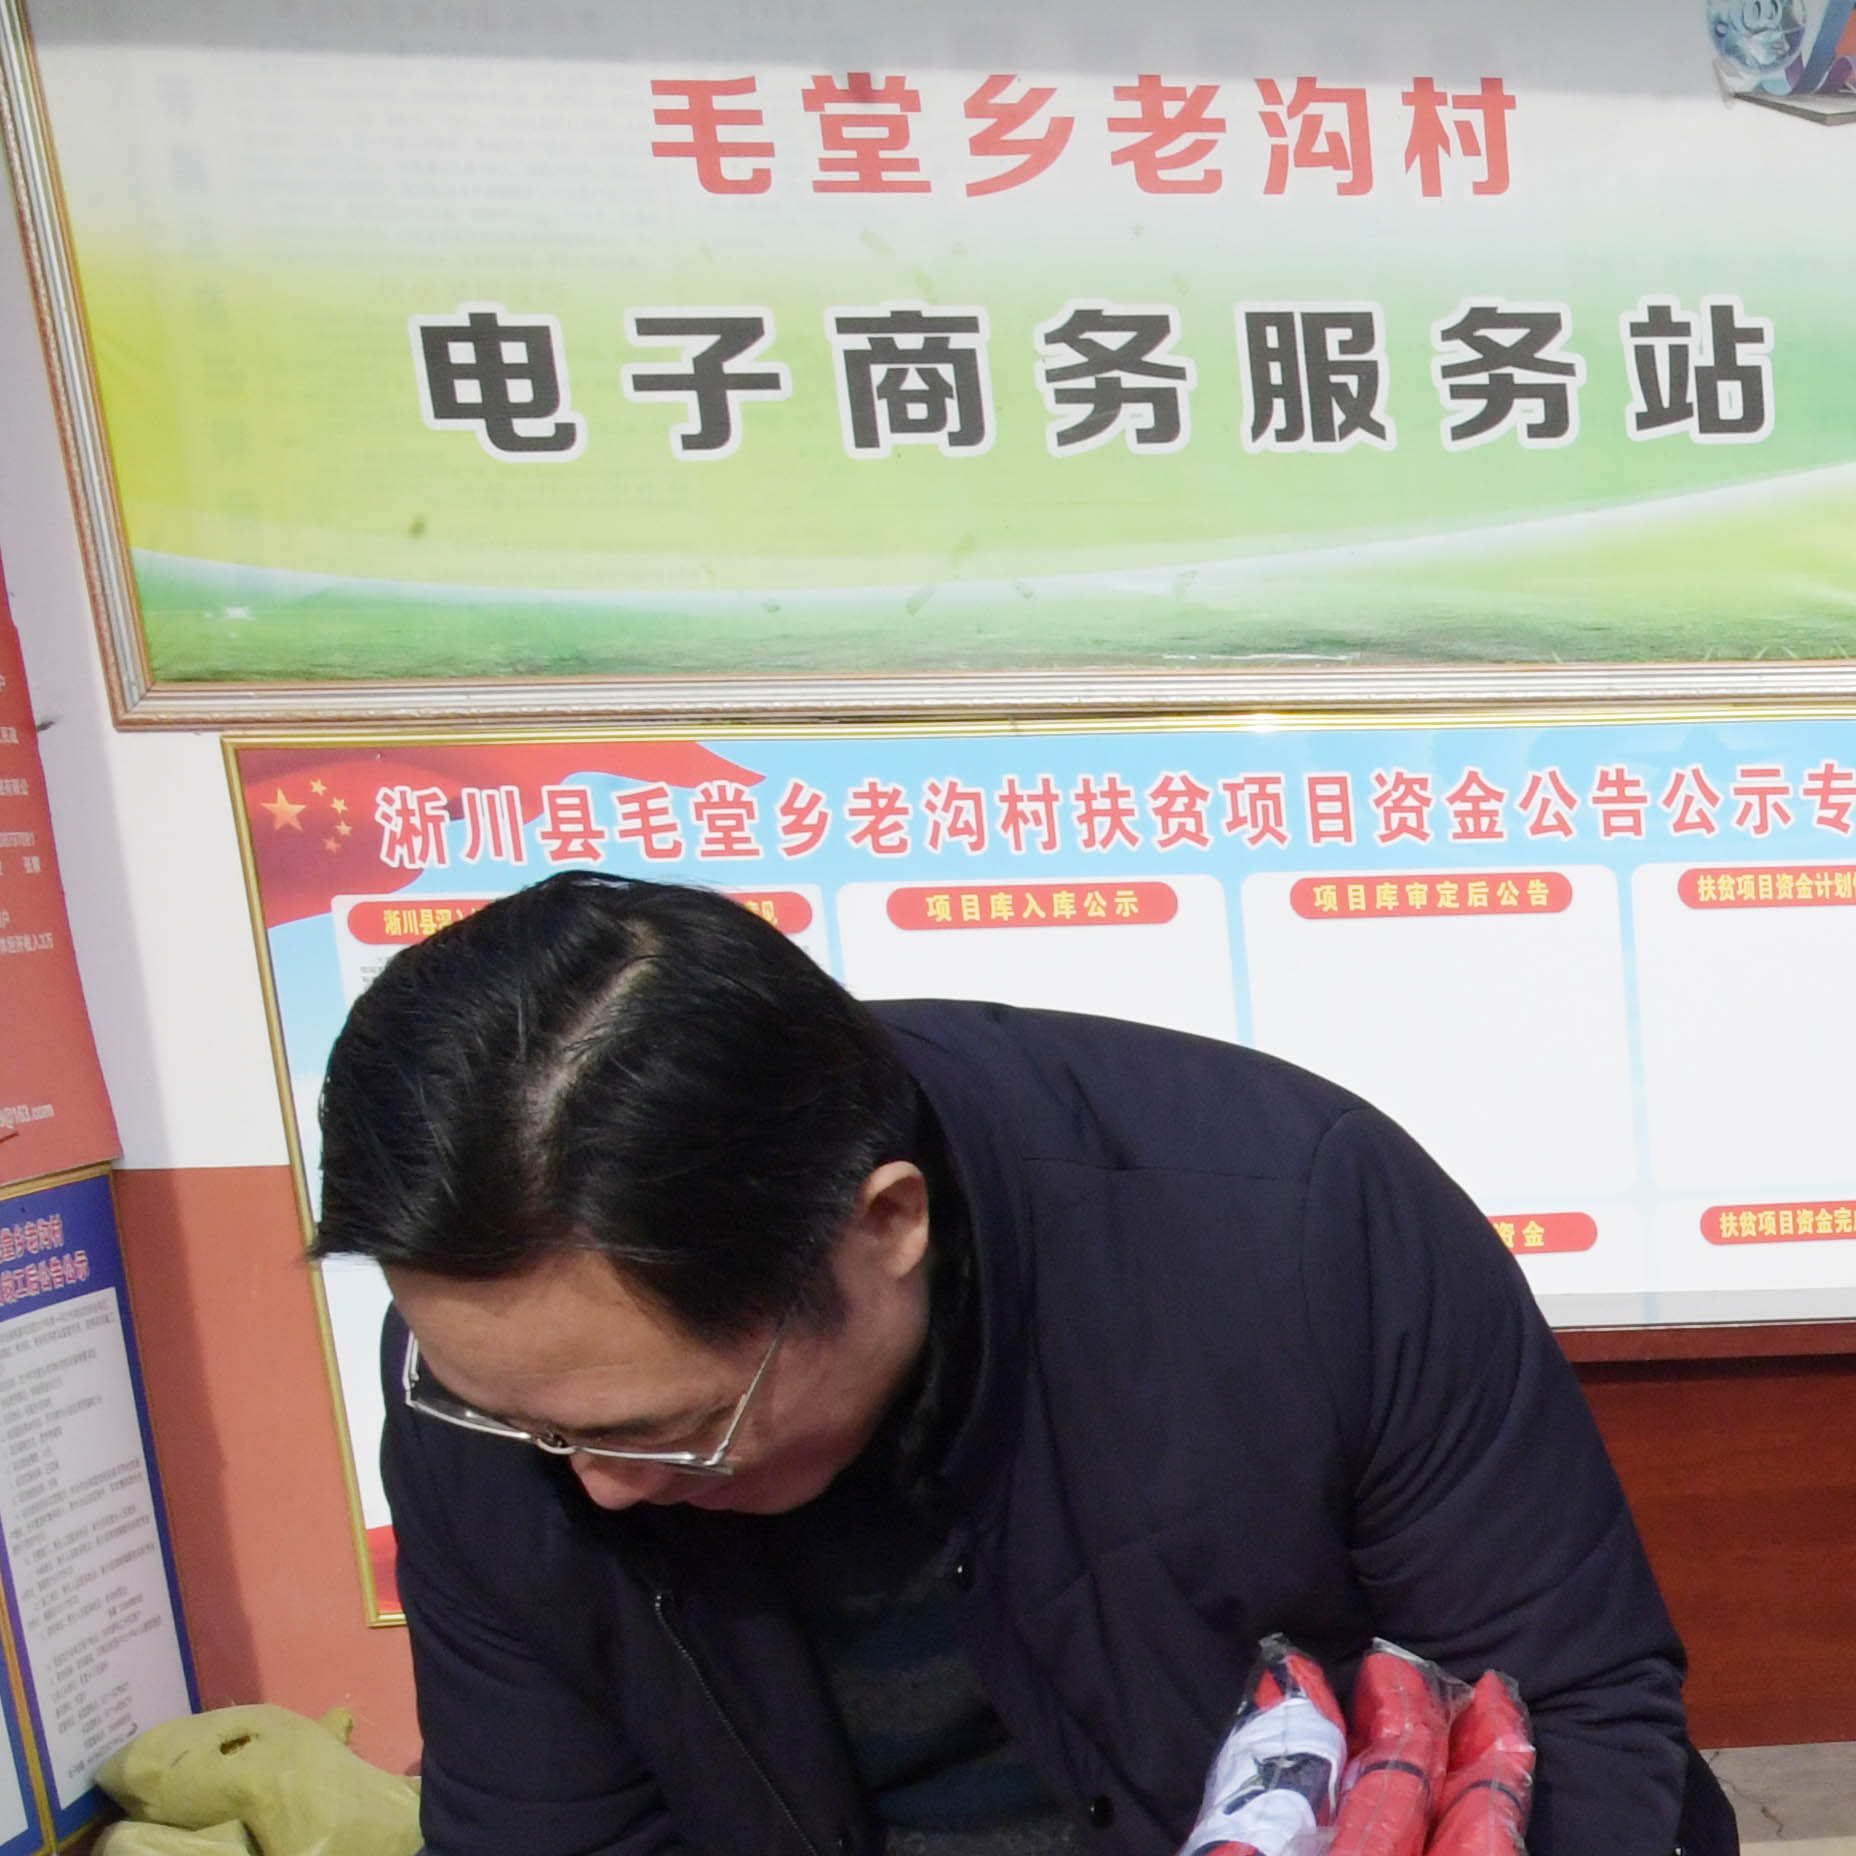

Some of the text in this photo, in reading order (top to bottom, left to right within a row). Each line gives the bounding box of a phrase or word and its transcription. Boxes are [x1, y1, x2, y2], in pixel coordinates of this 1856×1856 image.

[649, 72, 1516, 198] 毛堂乡老沟村
[417, 304, 1766, 453] 电子商务服务站
[925, 888, 1142, 922] 项目库入库公示
[1312, 877, 1552, 914] 项目库审定后公告
